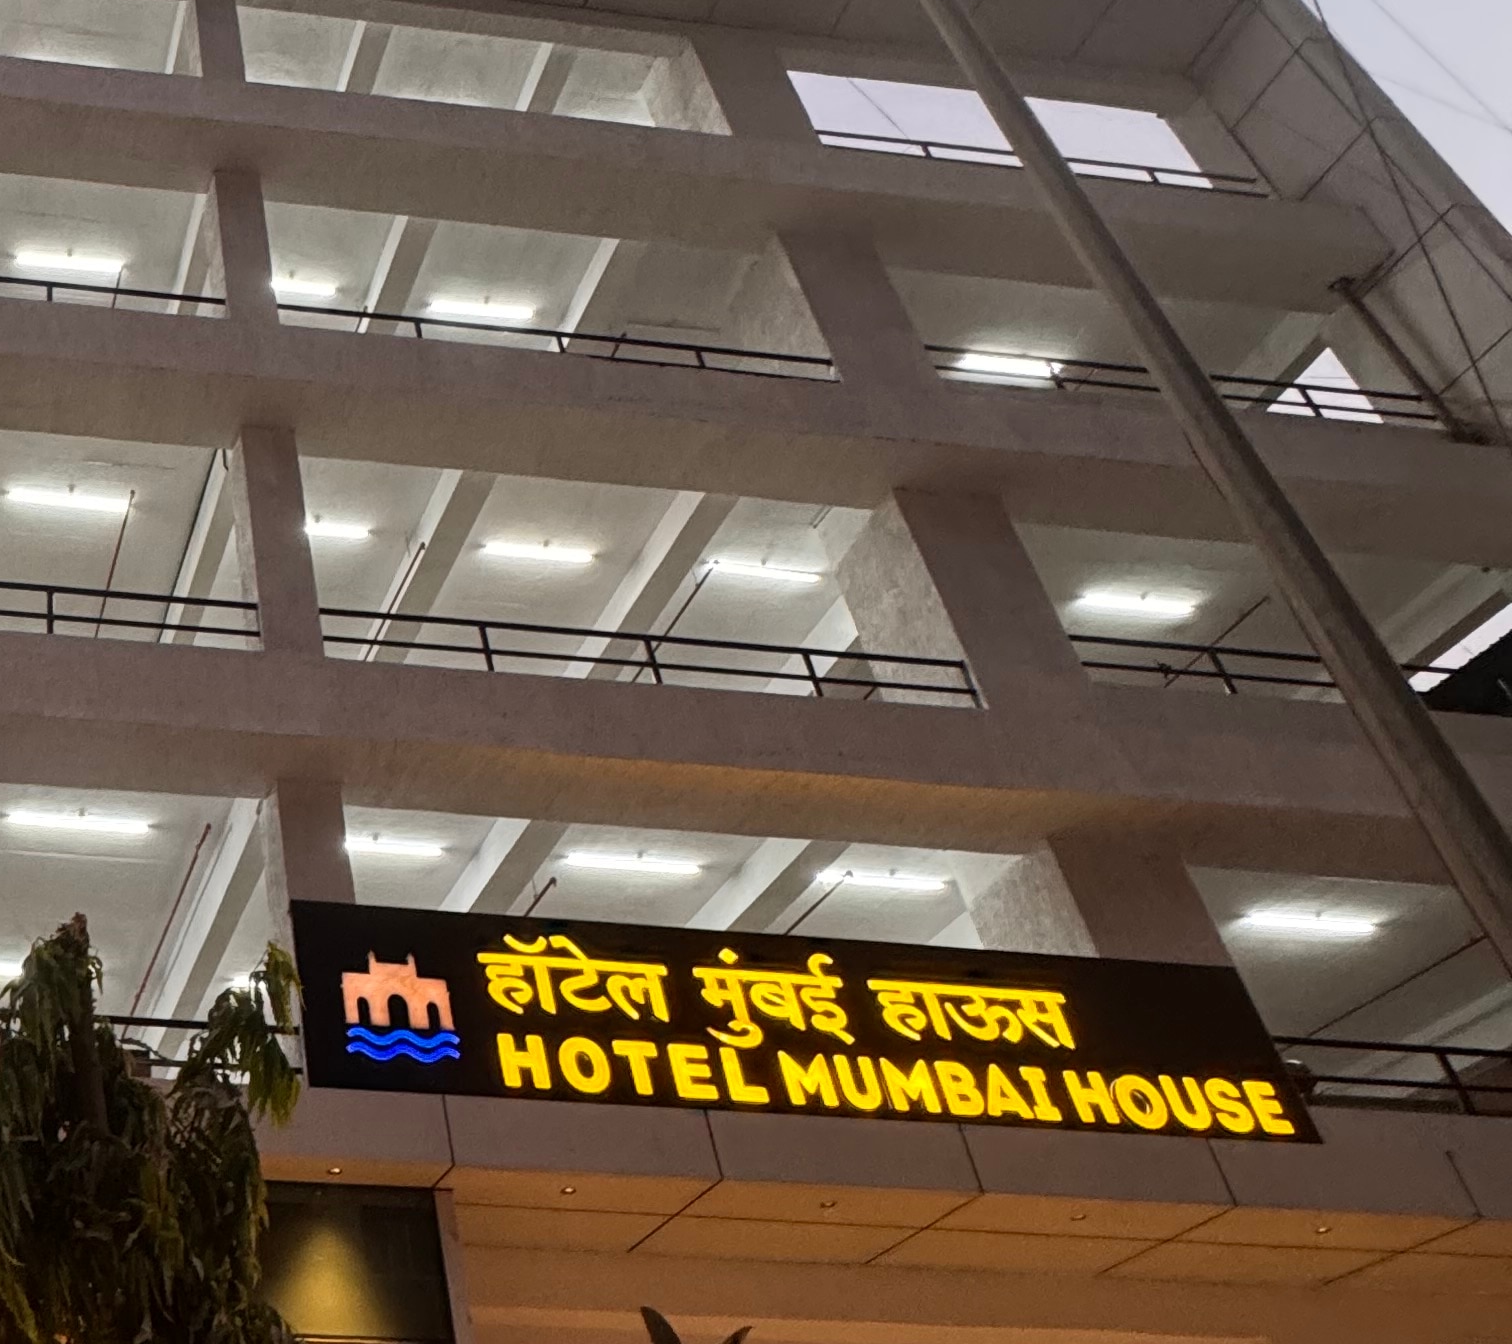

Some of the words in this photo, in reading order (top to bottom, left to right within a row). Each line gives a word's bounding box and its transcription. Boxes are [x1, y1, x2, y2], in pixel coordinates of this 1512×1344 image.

[477, 933, 670, 1023] हॉटेल
[692, 947, 855, 1049] मुंबई
[866, 979, 1076, 1050] हाऊस
[496, 1033, 770, 1105] HOTEL
[776, 1051, 1063, 1124] MUMBAI
[1063, 1069, 1296, 1136] HOUSE
